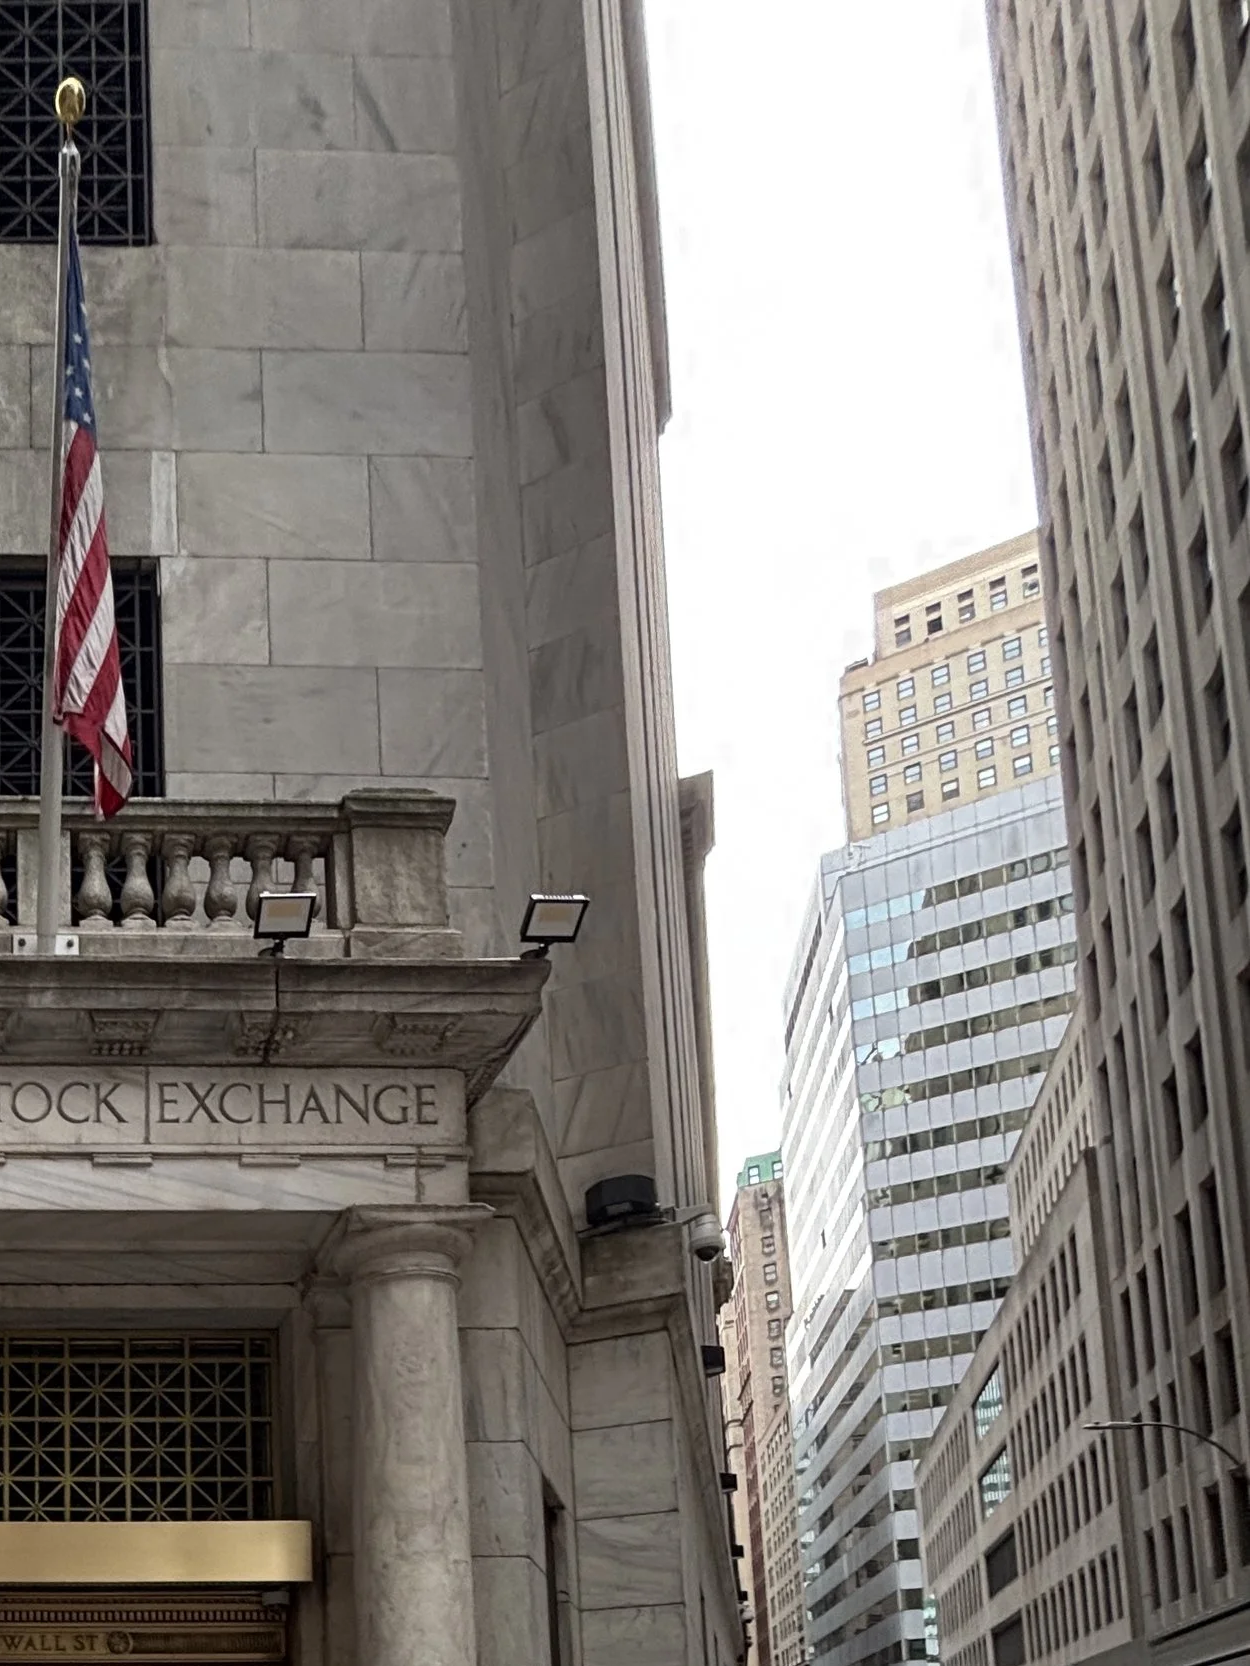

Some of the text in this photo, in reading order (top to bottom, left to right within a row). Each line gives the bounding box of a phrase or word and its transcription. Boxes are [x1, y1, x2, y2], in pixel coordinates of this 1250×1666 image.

[155, 1081, 439, 1126] EXCHANGE
[0, 1634, 67, 1651] WALL
[71, 1635, 99, 1652] ST
